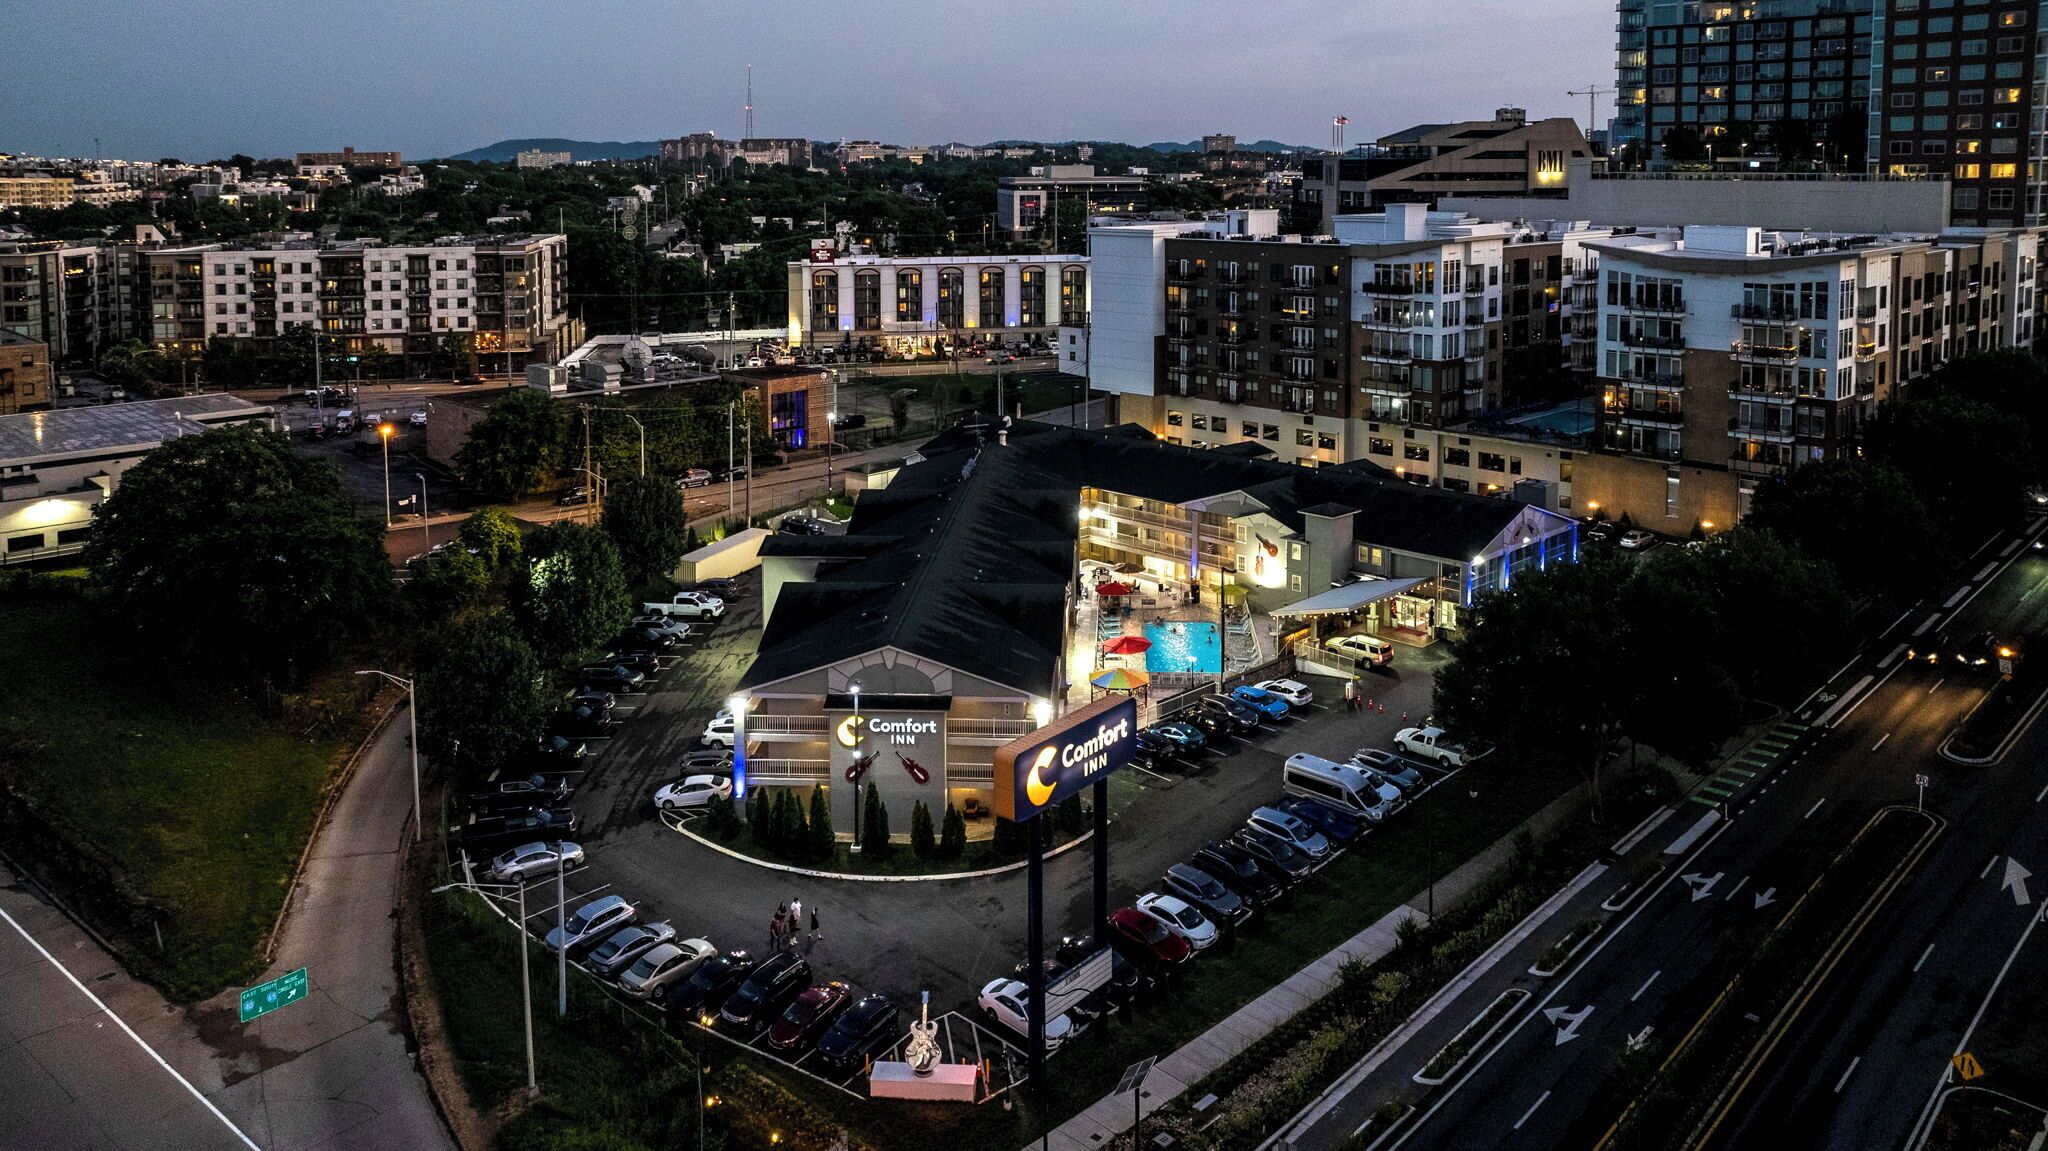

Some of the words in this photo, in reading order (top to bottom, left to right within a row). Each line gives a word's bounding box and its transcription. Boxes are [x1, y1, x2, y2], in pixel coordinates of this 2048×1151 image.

[1537, 150, 1564, 172] BMI
[869, 718, 937, 734] Comfort
[890, 735, 916, 745] INN
[1062, 718, 1128, 768] Comfort
[1083, 752, 1108, 777] INN
[242, 990, 257, 1000] EAST
